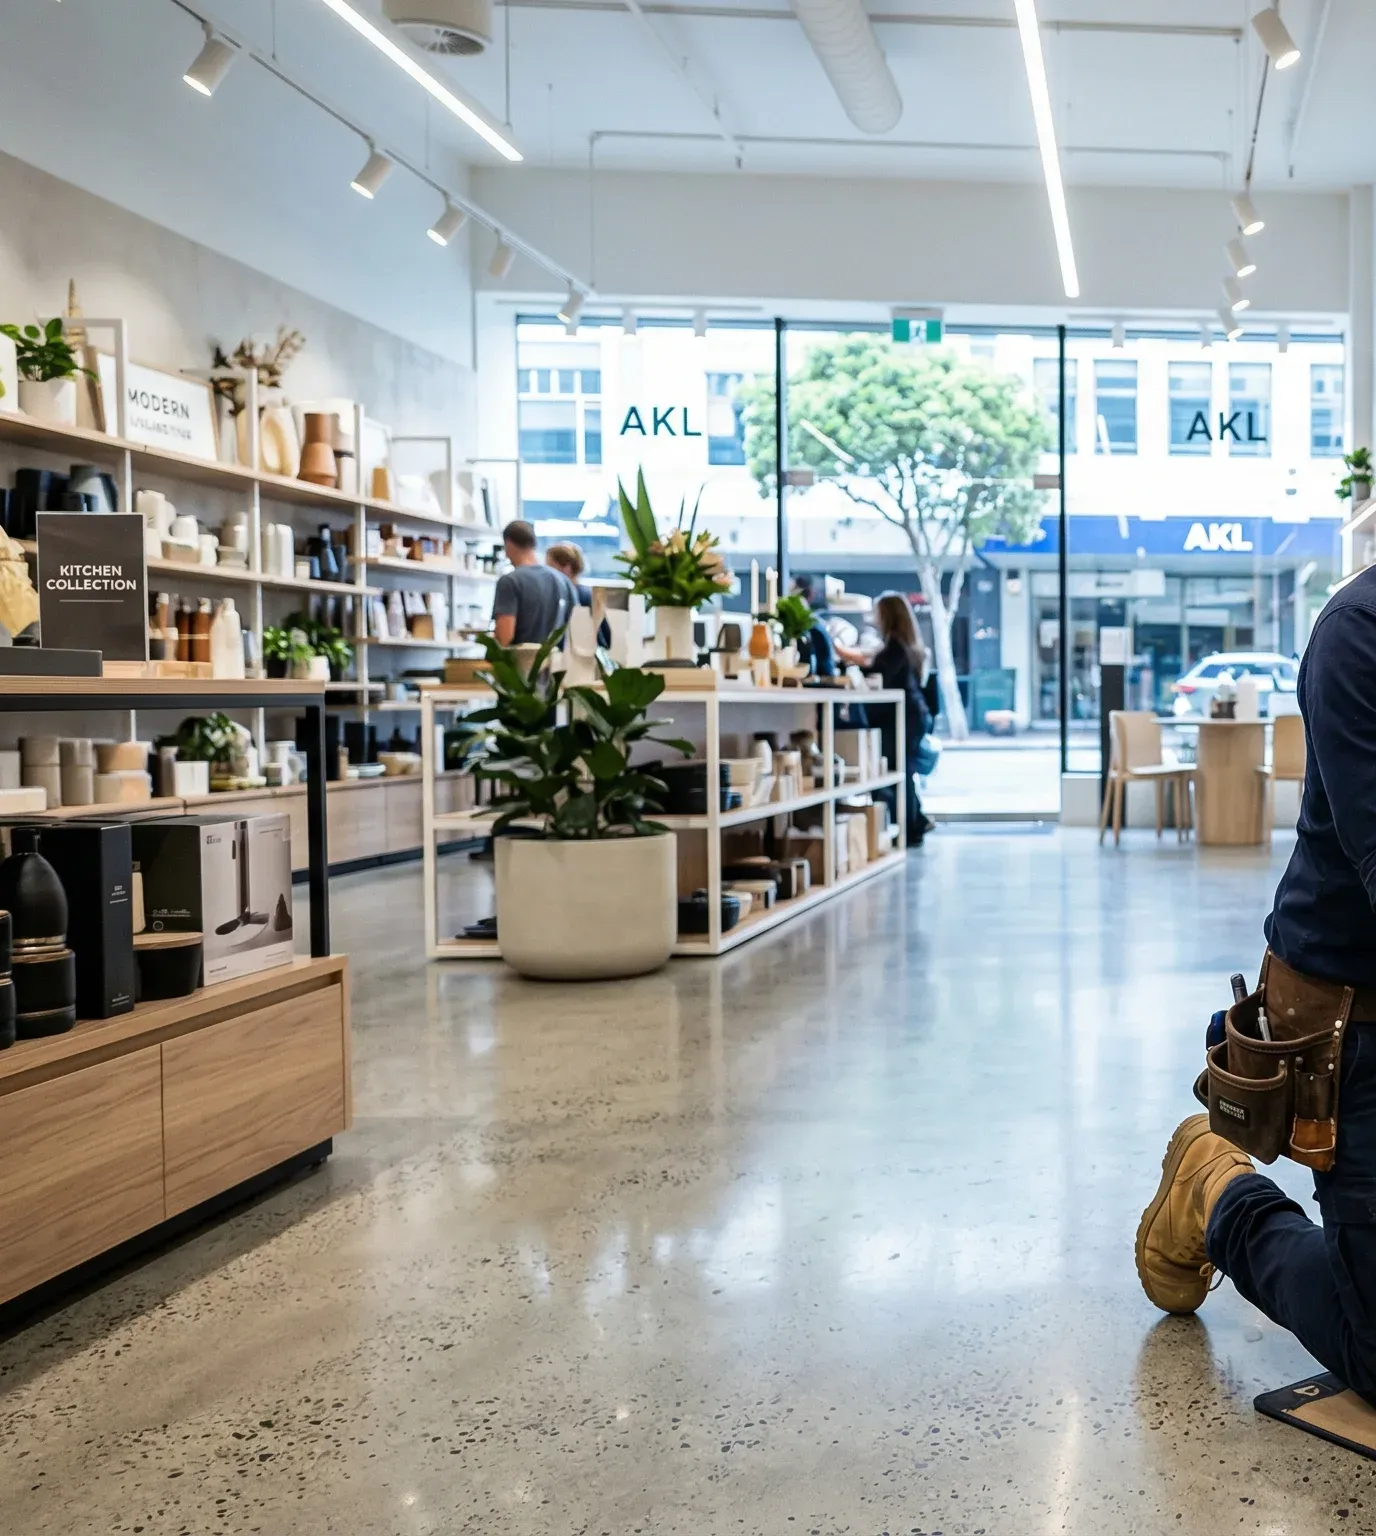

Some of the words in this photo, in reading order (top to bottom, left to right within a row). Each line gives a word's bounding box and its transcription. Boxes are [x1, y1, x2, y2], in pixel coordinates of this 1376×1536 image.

[127, 387, 190, 419] MODERN
[619, 406, 702, 436] AKL
[1186, 410, 1268, 441] AKL
[1183, 522, 1254, 552] AKL
[46, 579, 137, 591] COLLECTION
[60, 564, 122, 577] KITCHEN
